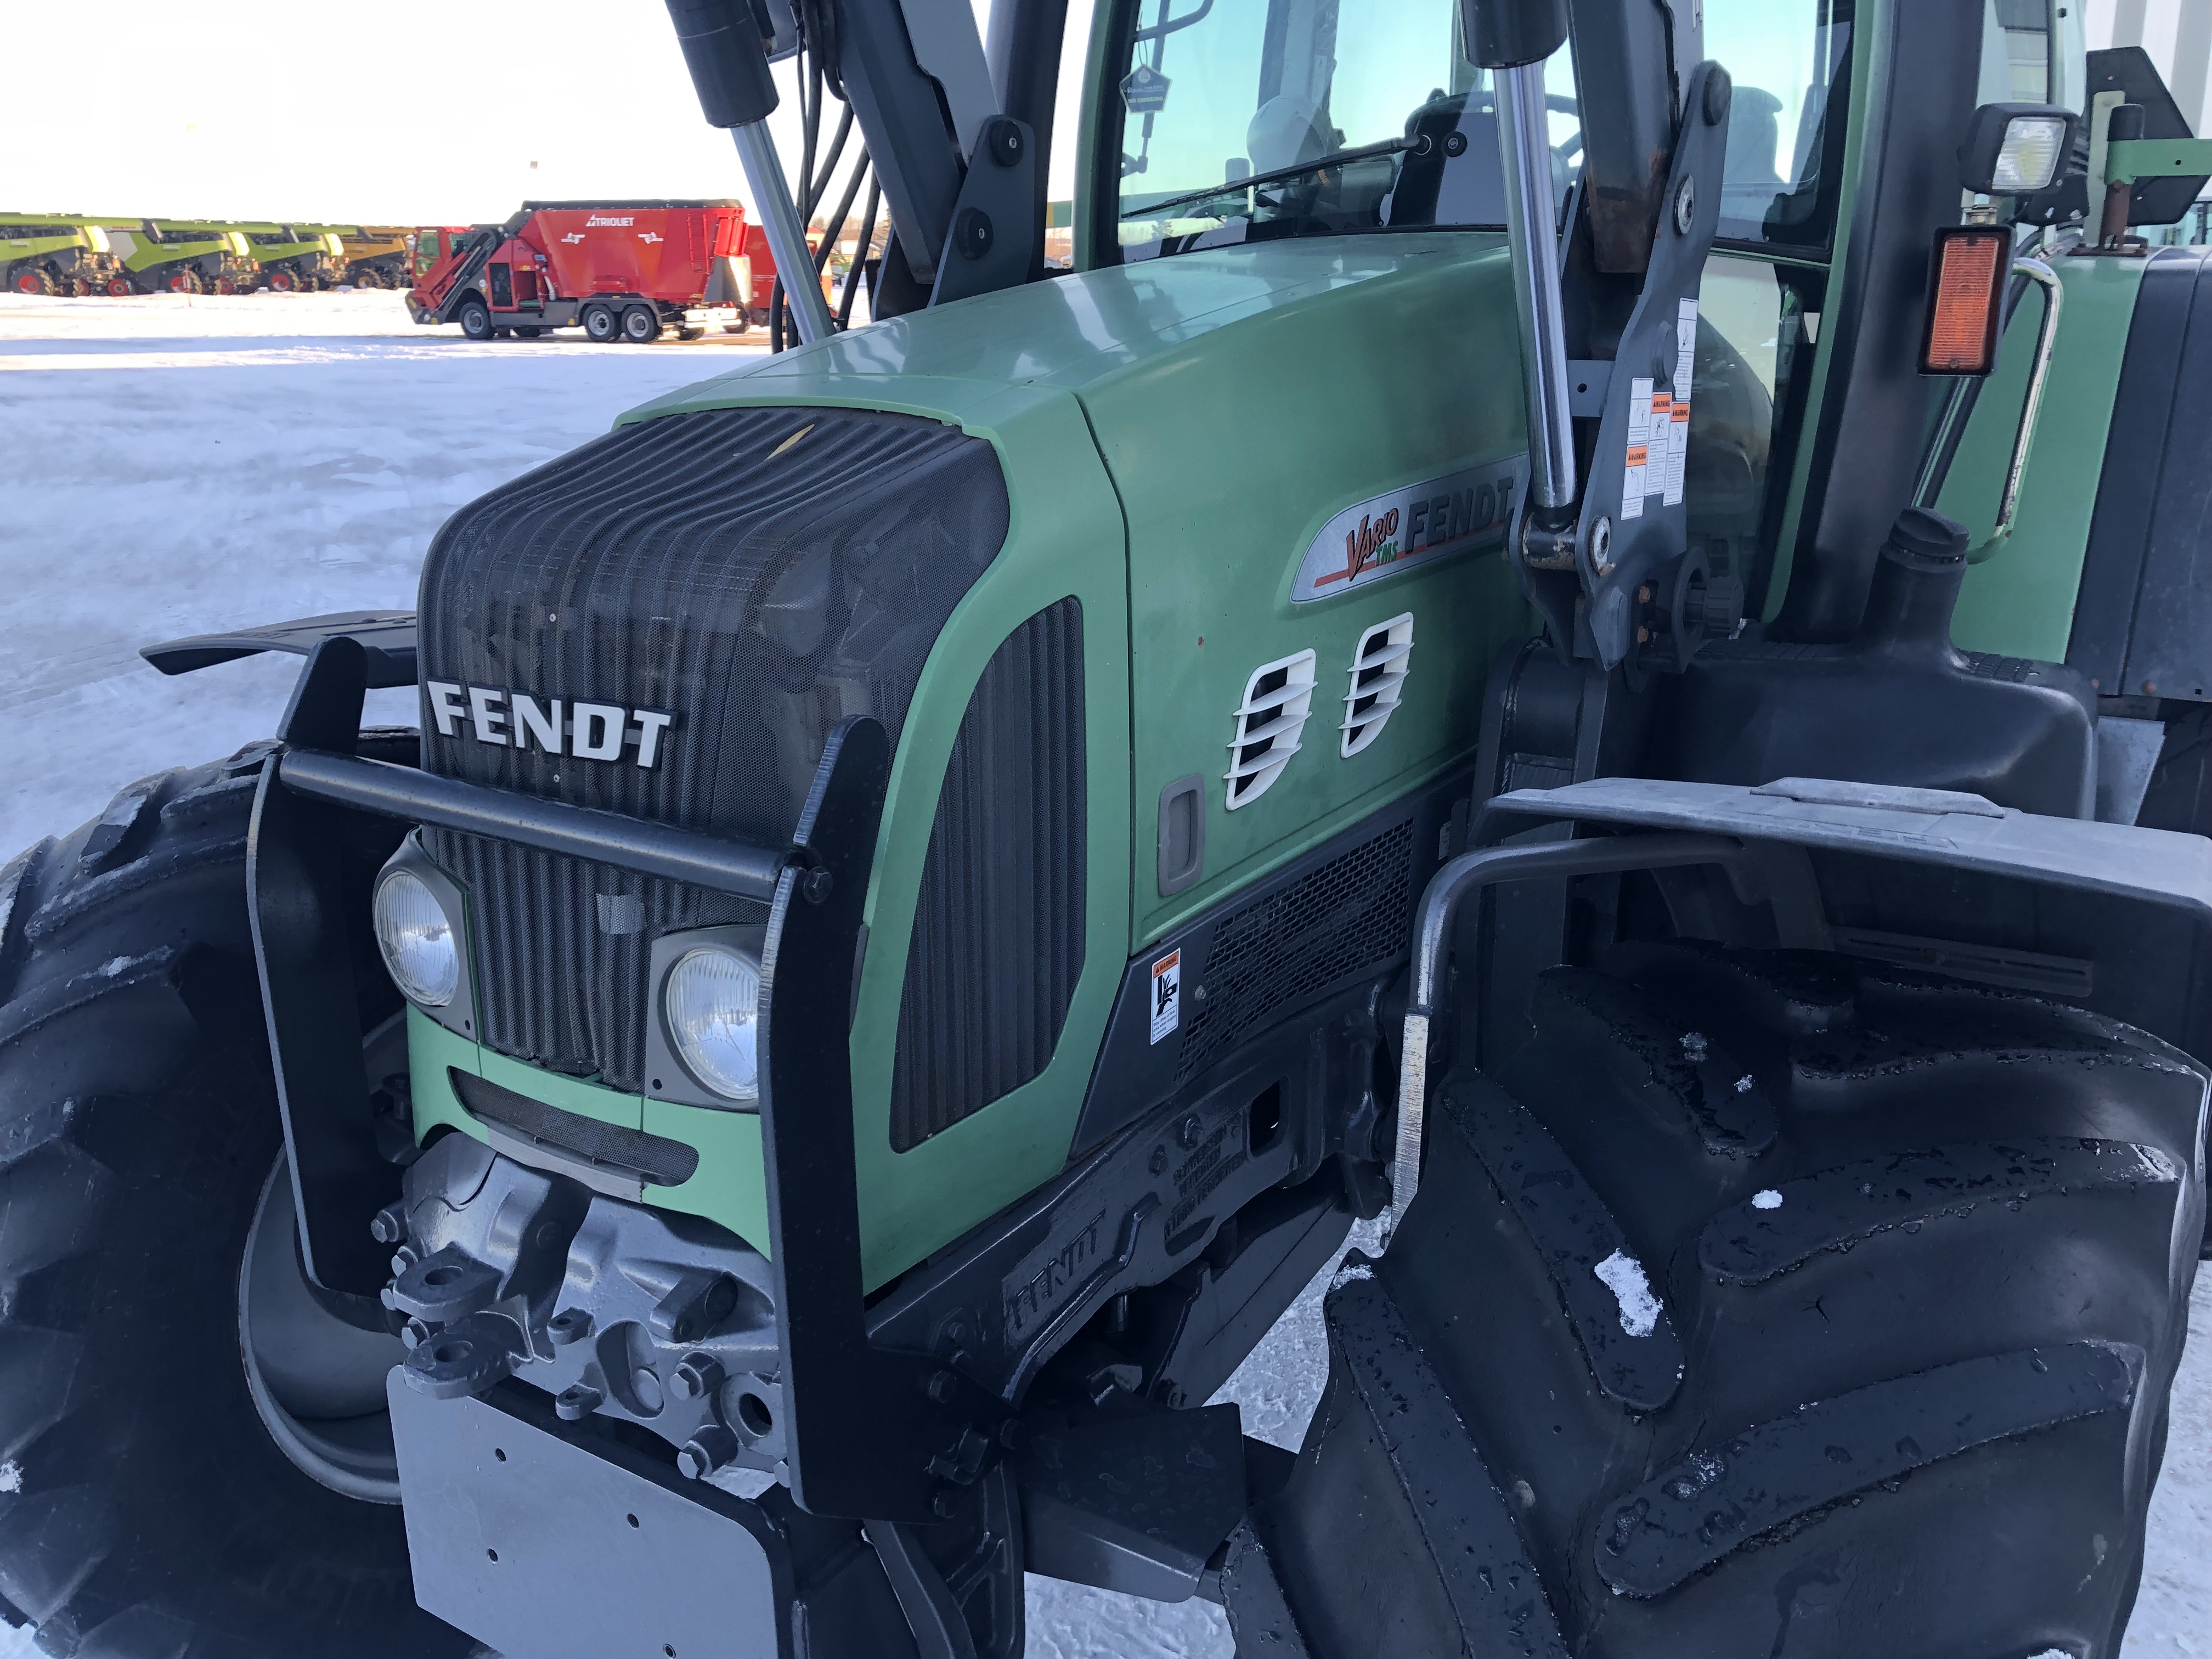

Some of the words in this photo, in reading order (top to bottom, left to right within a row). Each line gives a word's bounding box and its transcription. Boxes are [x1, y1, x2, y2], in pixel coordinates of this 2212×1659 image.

[1631, 452, 1646, 460] WARNING
[1405, 476, 1514, 554] FENDT
[1376, 541, 1398, 566] TMS
[427, 680, 673, 769] FENDT
[1160, 956, 1177, 970] WARNING
